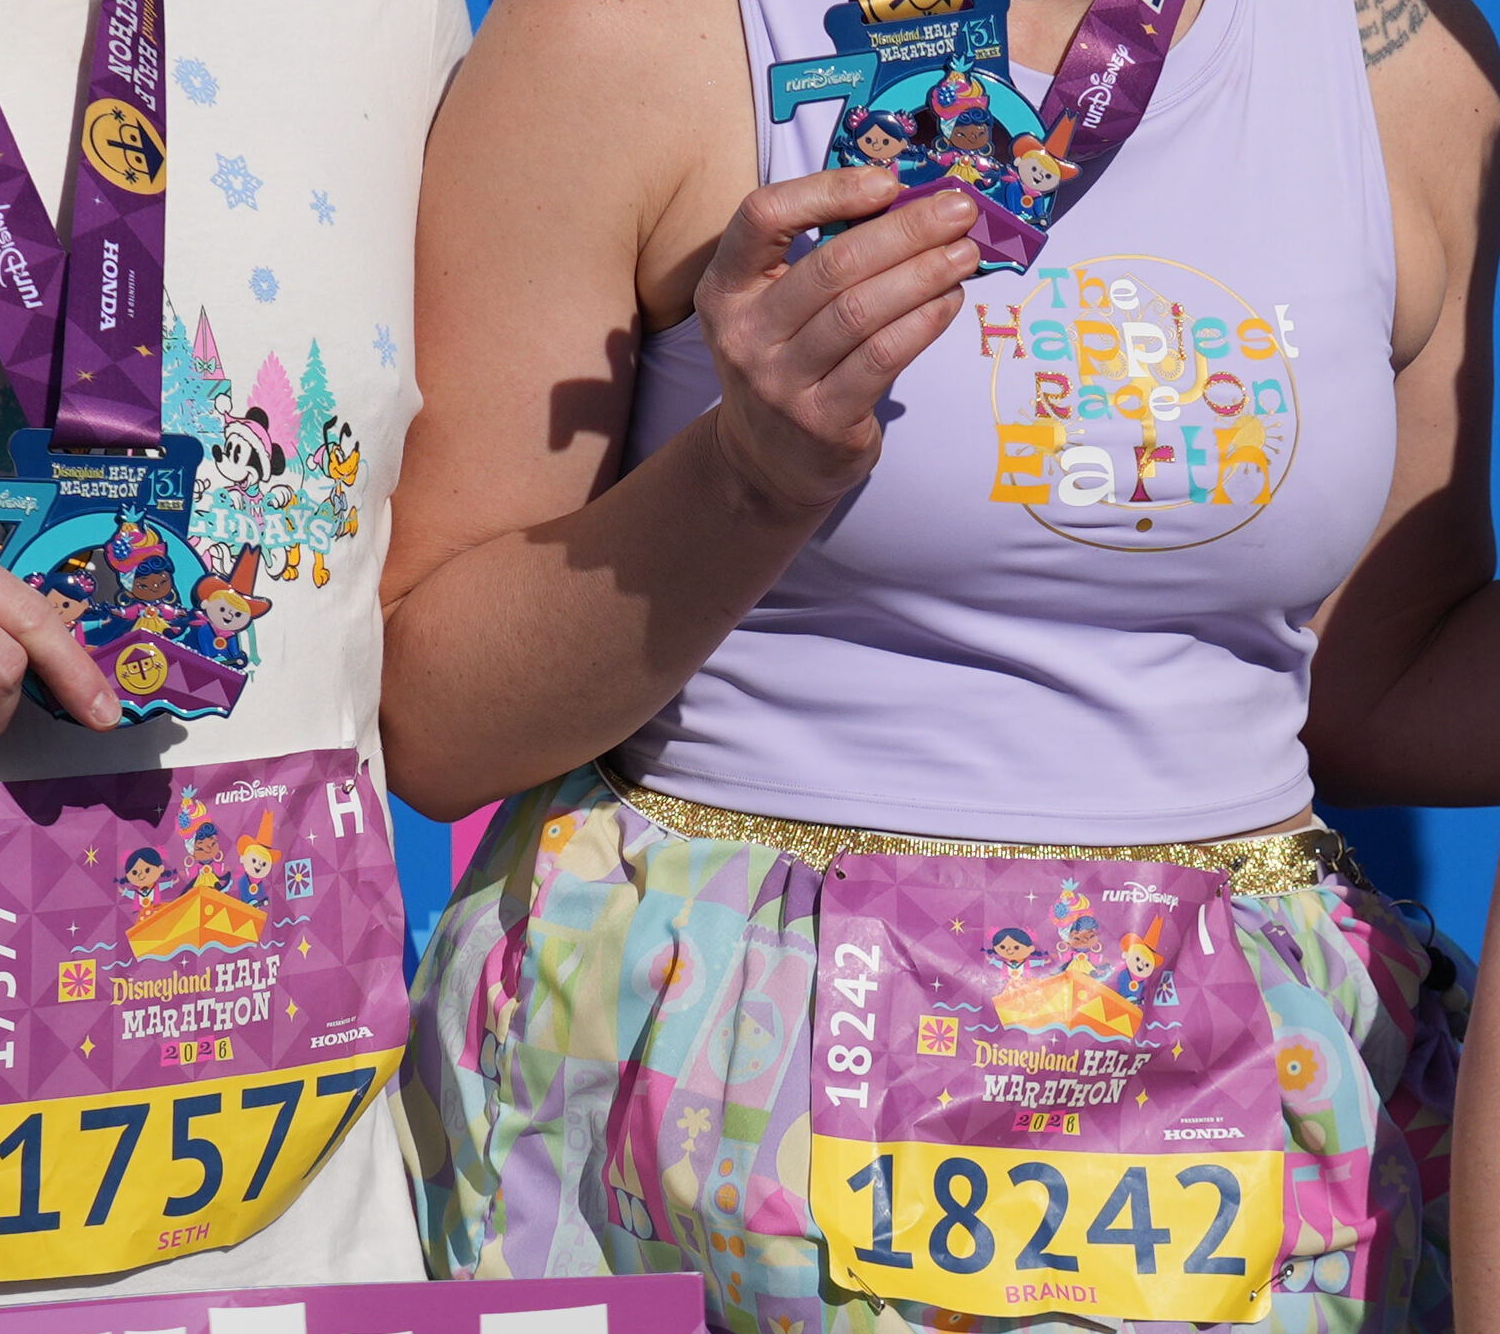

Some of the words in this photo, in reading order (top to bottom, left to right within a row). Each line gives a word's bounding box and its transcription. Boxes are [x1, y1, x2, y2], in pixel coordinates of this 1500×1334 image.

[867, 28, 920, 48] Disneyland
[923, 22, 960, 40] HALF
[877, 38, 955, 62] MARATHON
[962, 15, 999, 57] 13.1
[134, 37, 159, 112] HALF
[785, 67, 864, 92] runDisney
[1078, 44, 1136, 129] runDisney
[100, 239, 119, 331] HONDA
[1038, 268, 1140, 310] The
[975, 302, 1299, 378] Happiest
[1035, 371, 1182, 421] Race
[1203, 371, 1288, 417] On
[52, 463, 105, 479] Disneyland
[108, 465, 147, 481] HALF
[989, 424, 1273, 507] Earth
[60, 480, 139, 499] MARATHON
[148, 467, 184, 506] 13.1
[215, 780, 288, 804] runDisney
[327, 781, 364, 837] H
[1102, 881, 1178, 910] runDisney
[110, 965, 212, 1006] Disneyland
[214, 955, 281, 995] HALF
[122, 991, 273, 1040] MARATHON
[327, 1017, 349, 1028] PRESENTED
[825, 943, 880, 1109] 18242
[164, 1039, 228, 1062] 2026
[310, 1025, 375, 1049] HONDA
[972, 1037, 1079, 1075] Disneyland
[1080, 1049, 1152, 1077] HALF
[982, 1075, 1127, 1109] MARATHON
[1016, 1112, 1078, 1134] 2026
[1163, 1127, 1245, 1140] HONDA
[846, 1153, 1246, 1276] 18242
[157, 1223, 211, 1251] SETH
[1005, 1284, 1098, 1304] BRANDI
